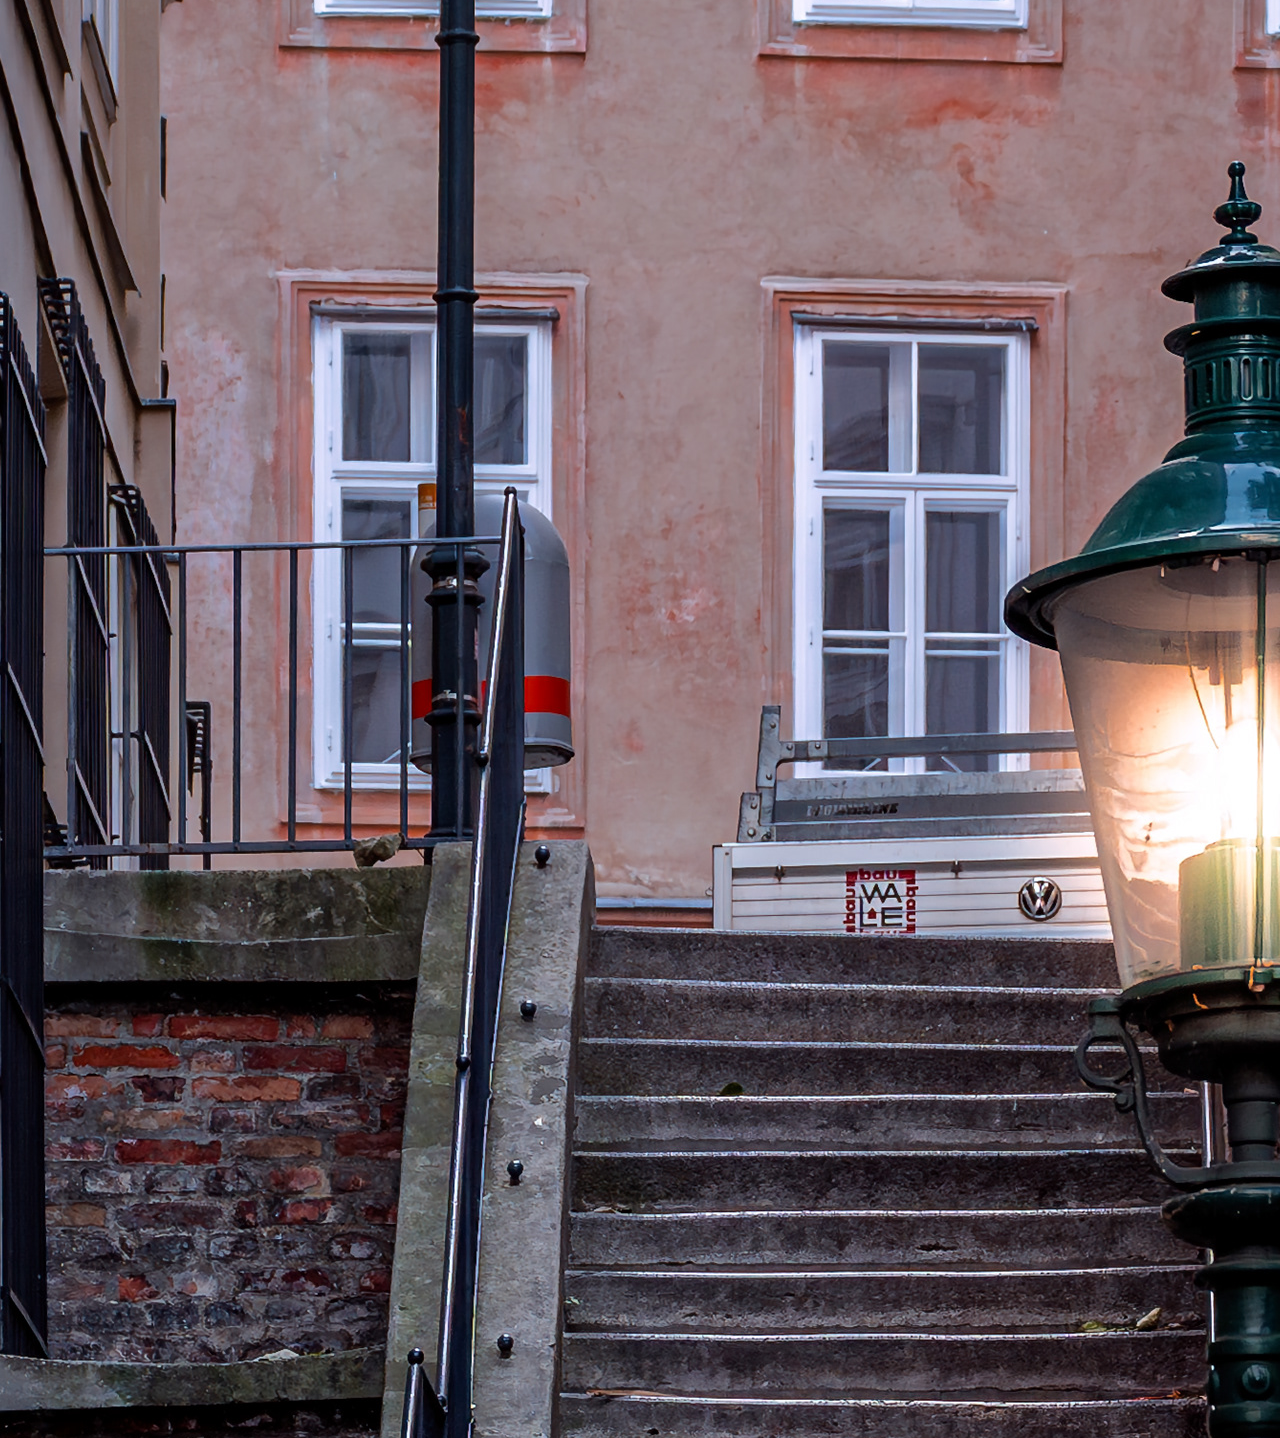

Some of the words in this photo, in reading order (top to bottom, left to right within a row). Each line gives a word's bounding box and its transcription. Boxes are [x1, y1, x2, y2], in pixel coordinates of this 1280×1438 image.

[859, 868, 897, 880] bau
[843, 888, 856, 924] bau
[860, 883, 902, 904] WA
[906, 886, 919, 922] bau
